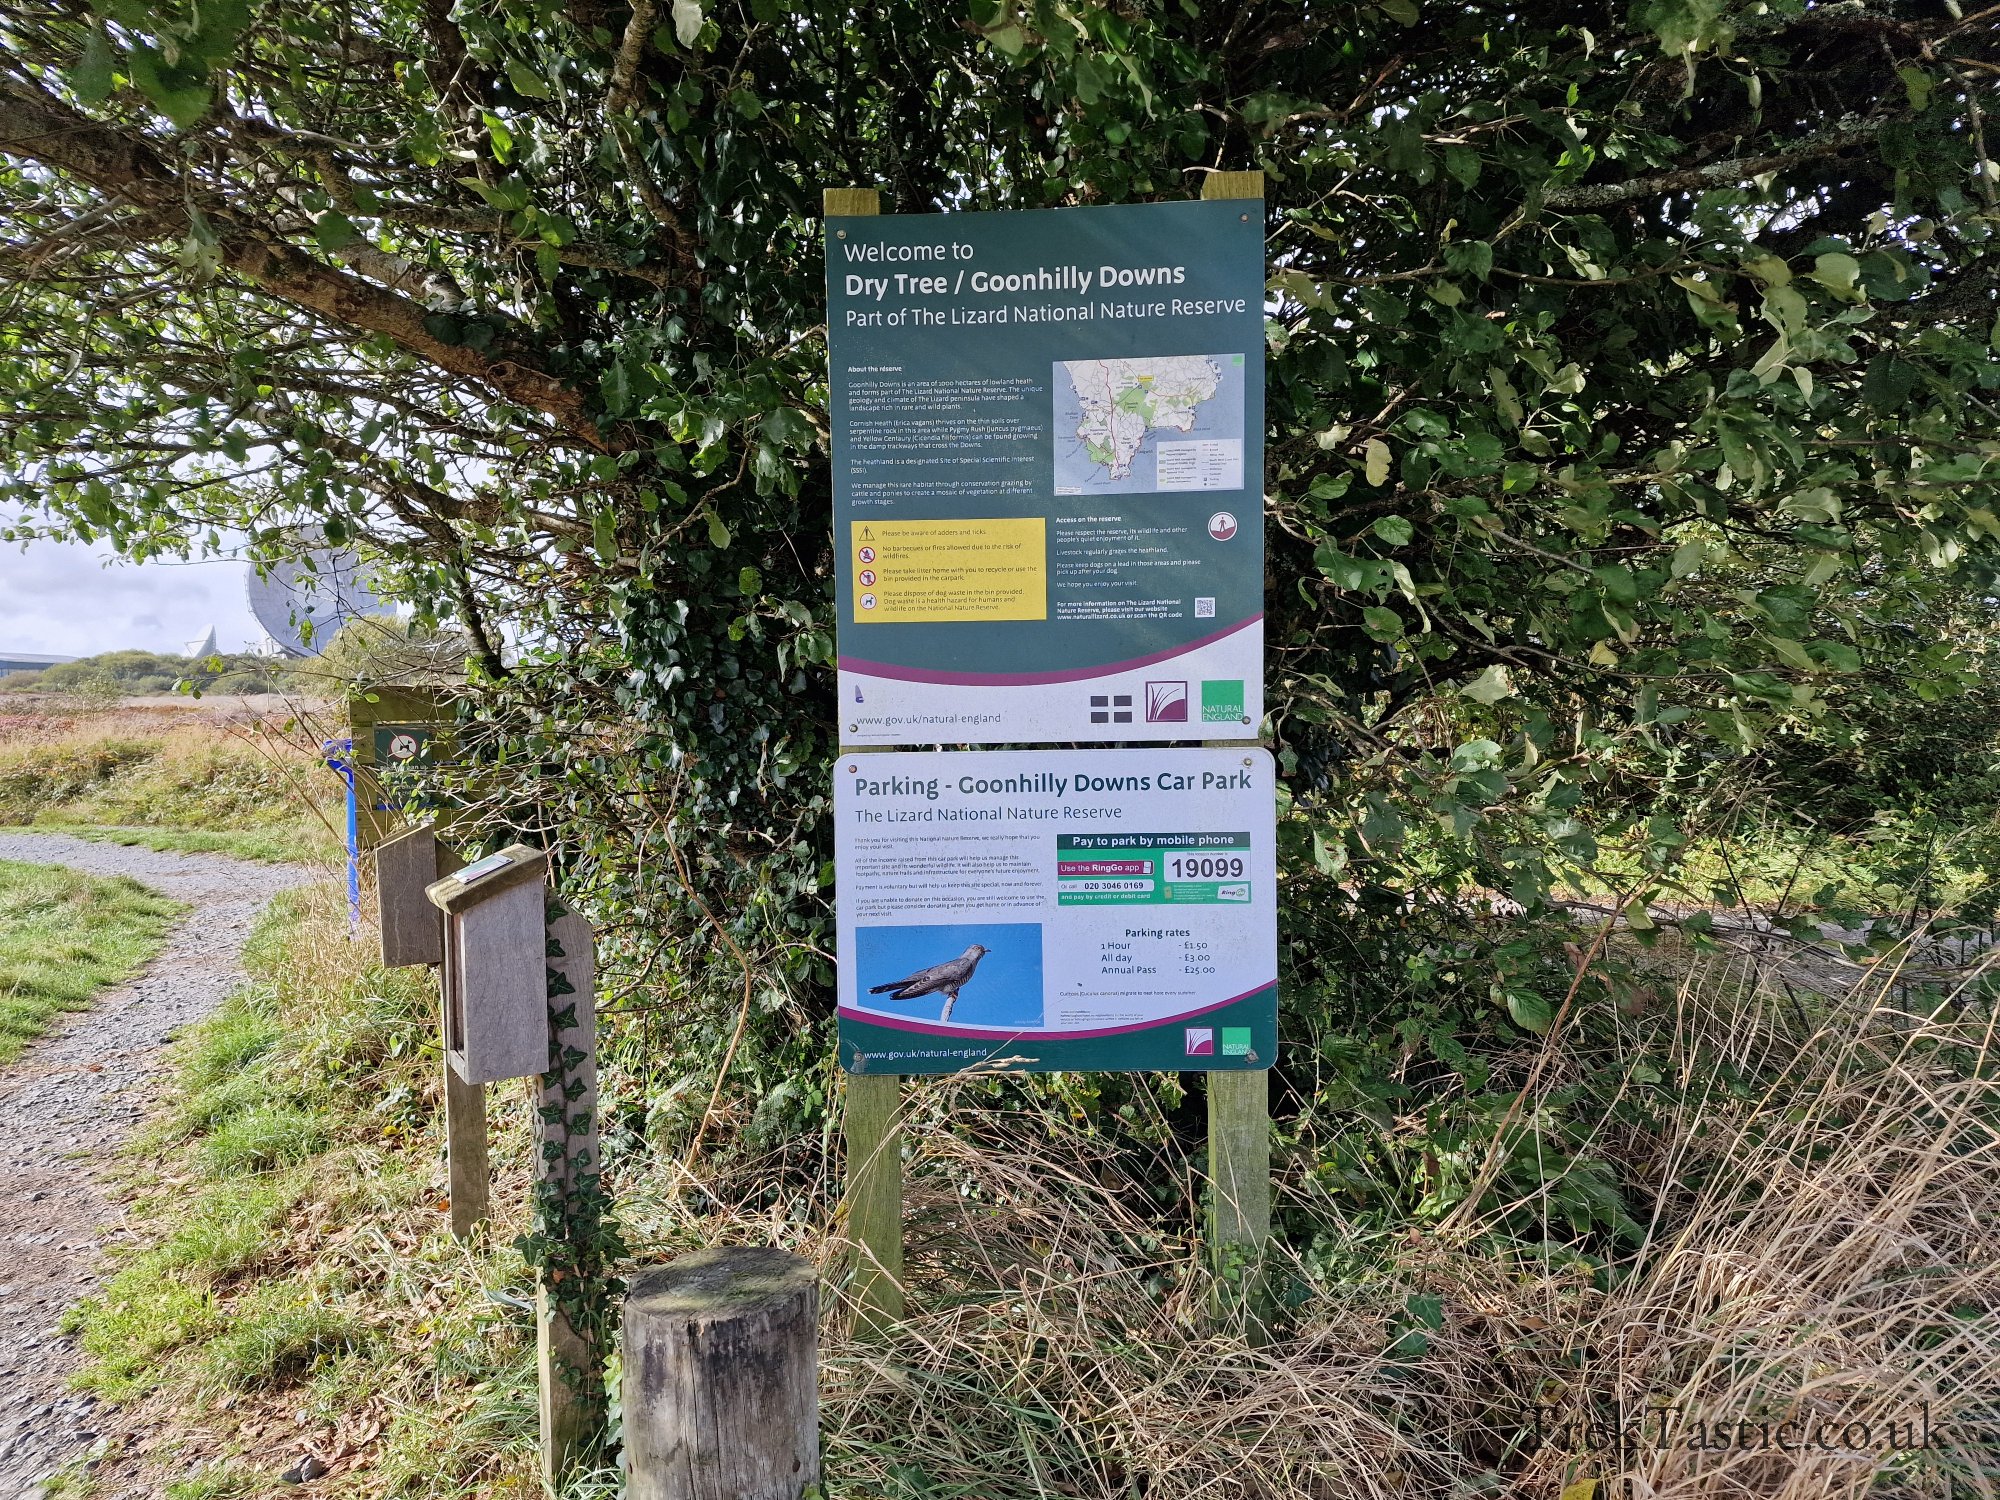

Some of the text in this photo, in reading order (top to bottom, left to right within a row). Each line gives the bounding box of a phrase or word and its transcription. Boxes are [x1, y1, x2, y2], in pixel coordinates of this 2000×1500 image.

[844, 241, 974, 262] Welcome to
[846, 265, 1185, 301] Dry Tree / Goonhilly Downs
[847, 298, 1246, 327] Part of The Lizard National Nature Reserve
[985, 566, 1006, 574] recycle
[894, 574, 921, 583] provided
[1101, 606, 1120, 614] please
[857, 713, 1000, 726] www.gov.uk/natural-england
[856, 775, 937, 801] Parking
[958, 772, 1066, 797] Goonhilly
[1074, 773, 1150, 792] Downs
[1157, 772, 1192, 790] Car
[1202, 769, 1252, 790] Park
[856, 805, 1122, 823] The Lizard National Nature Reserve
[1073, 834, 1234, 848] Pay to park by mobile phone
[1091, 864, 1122, 873] RingGo
[1172, 858, 1243, 877] 19099
[1126, 928, 1163, 939] Parking
[1184, 941, 1208, 950] £1.50
[1116, 954, 1132, 963] day
[1184, 954, 1210, 962] £3.00
[1185, 966, 1215, 975] £25.00
[864, 1048, 987, 1060] www.gov.uk/natural-england
